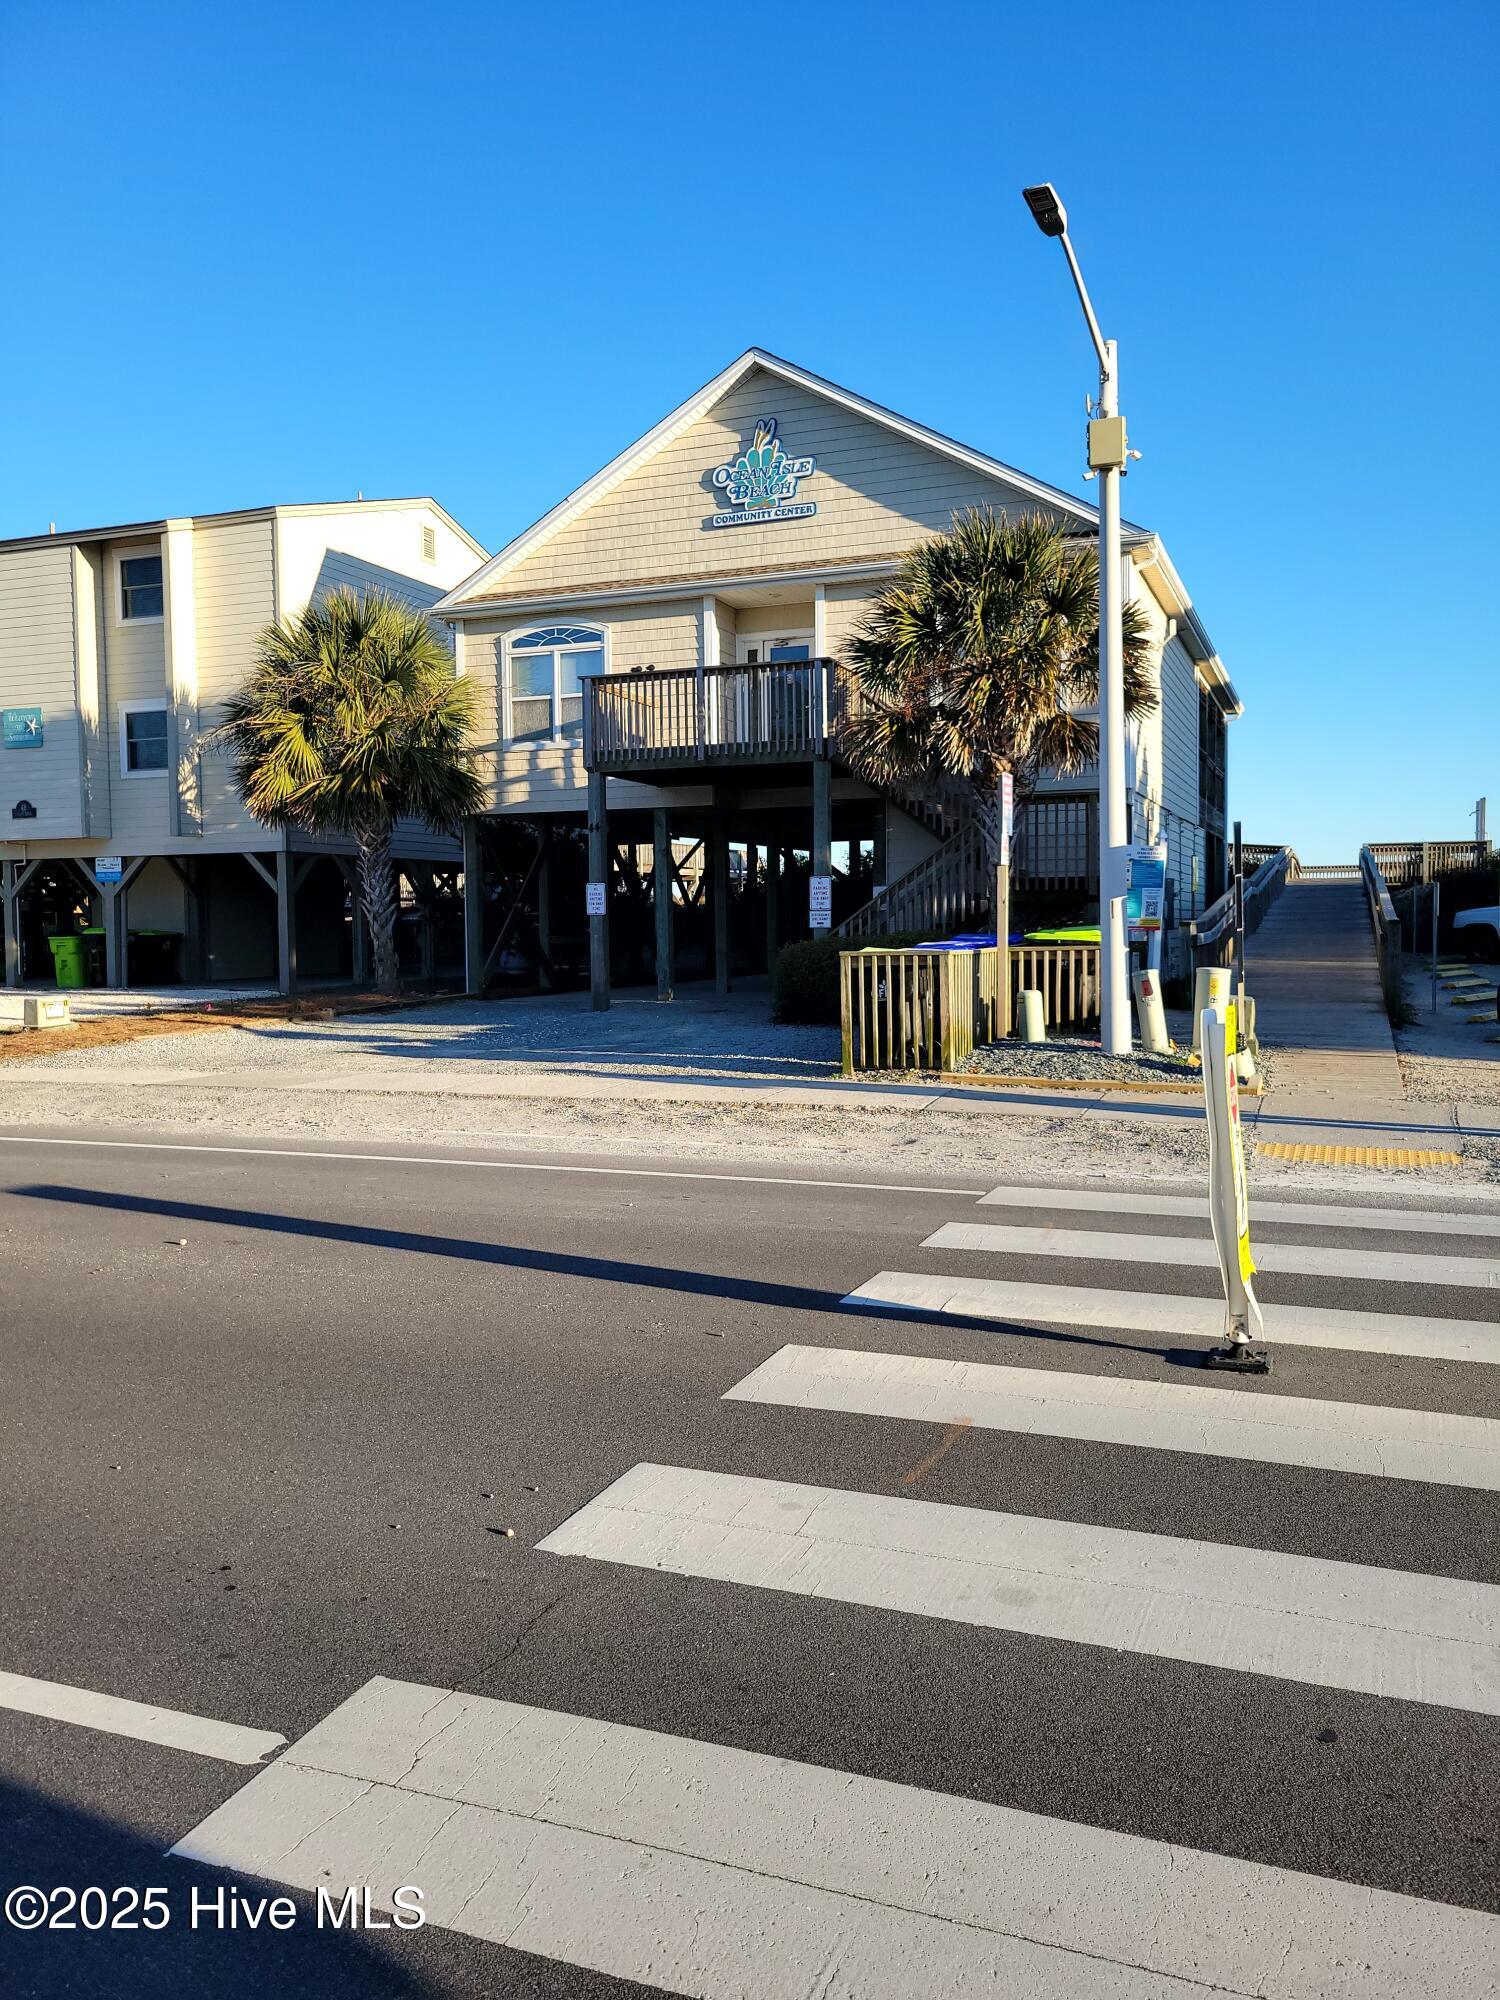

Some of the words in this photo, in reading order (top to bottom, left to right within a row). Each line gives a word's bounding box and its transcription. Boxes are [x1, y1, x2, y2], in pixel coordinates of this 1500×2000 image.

[715, 467, 771, 484] OCEAN
[771, 460, 811, 476] ISLE
[730, 482, 793, 499] BEACH
[715, 509, 772, 524] COMMUNITY
[774, 505, 813, 517] CENTER
